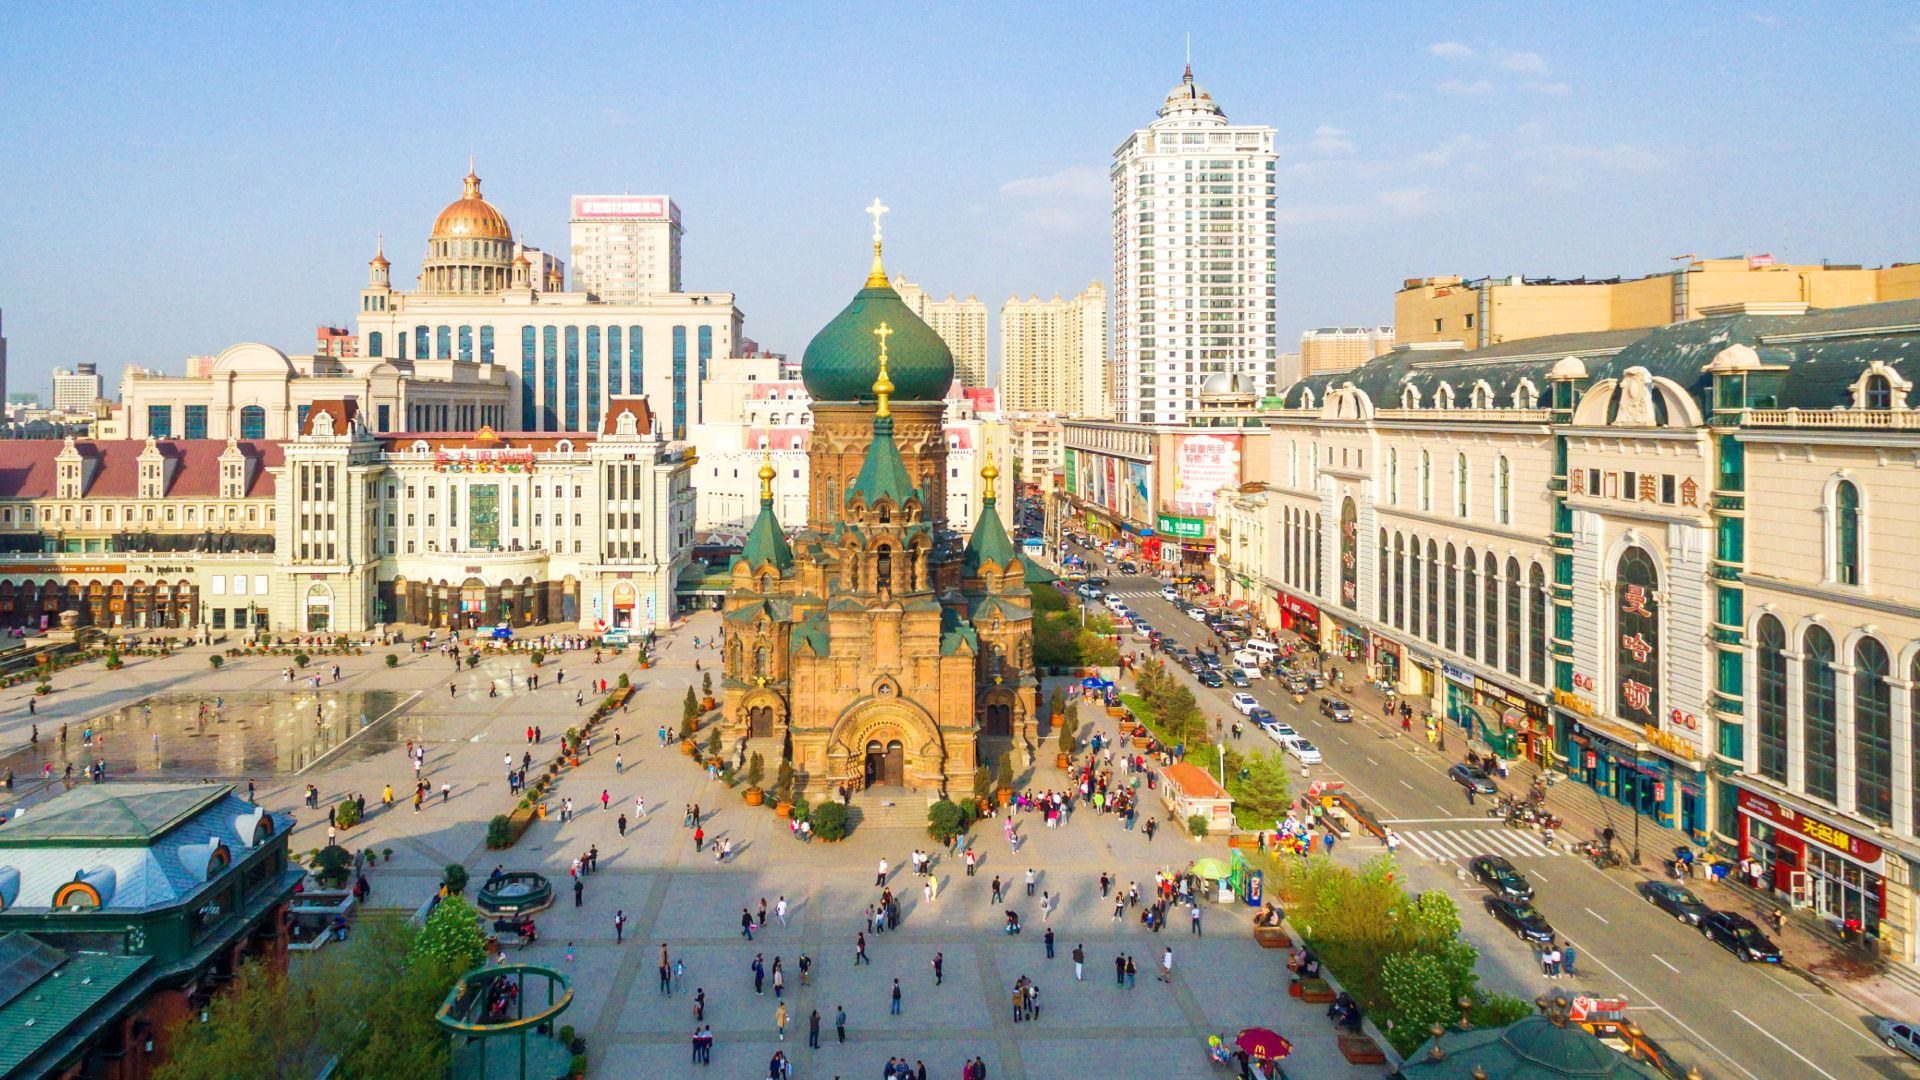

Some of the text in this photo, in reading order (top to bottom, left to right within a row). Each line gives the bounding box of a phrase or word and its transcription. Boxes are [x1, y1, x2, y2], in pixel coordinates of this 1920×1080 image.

[1569, 468, 1699, 508] 澳门美食
[1622, 583, 1652, 715] 曼哈顿
[1803, 817, 1849, 850] 无名缘
